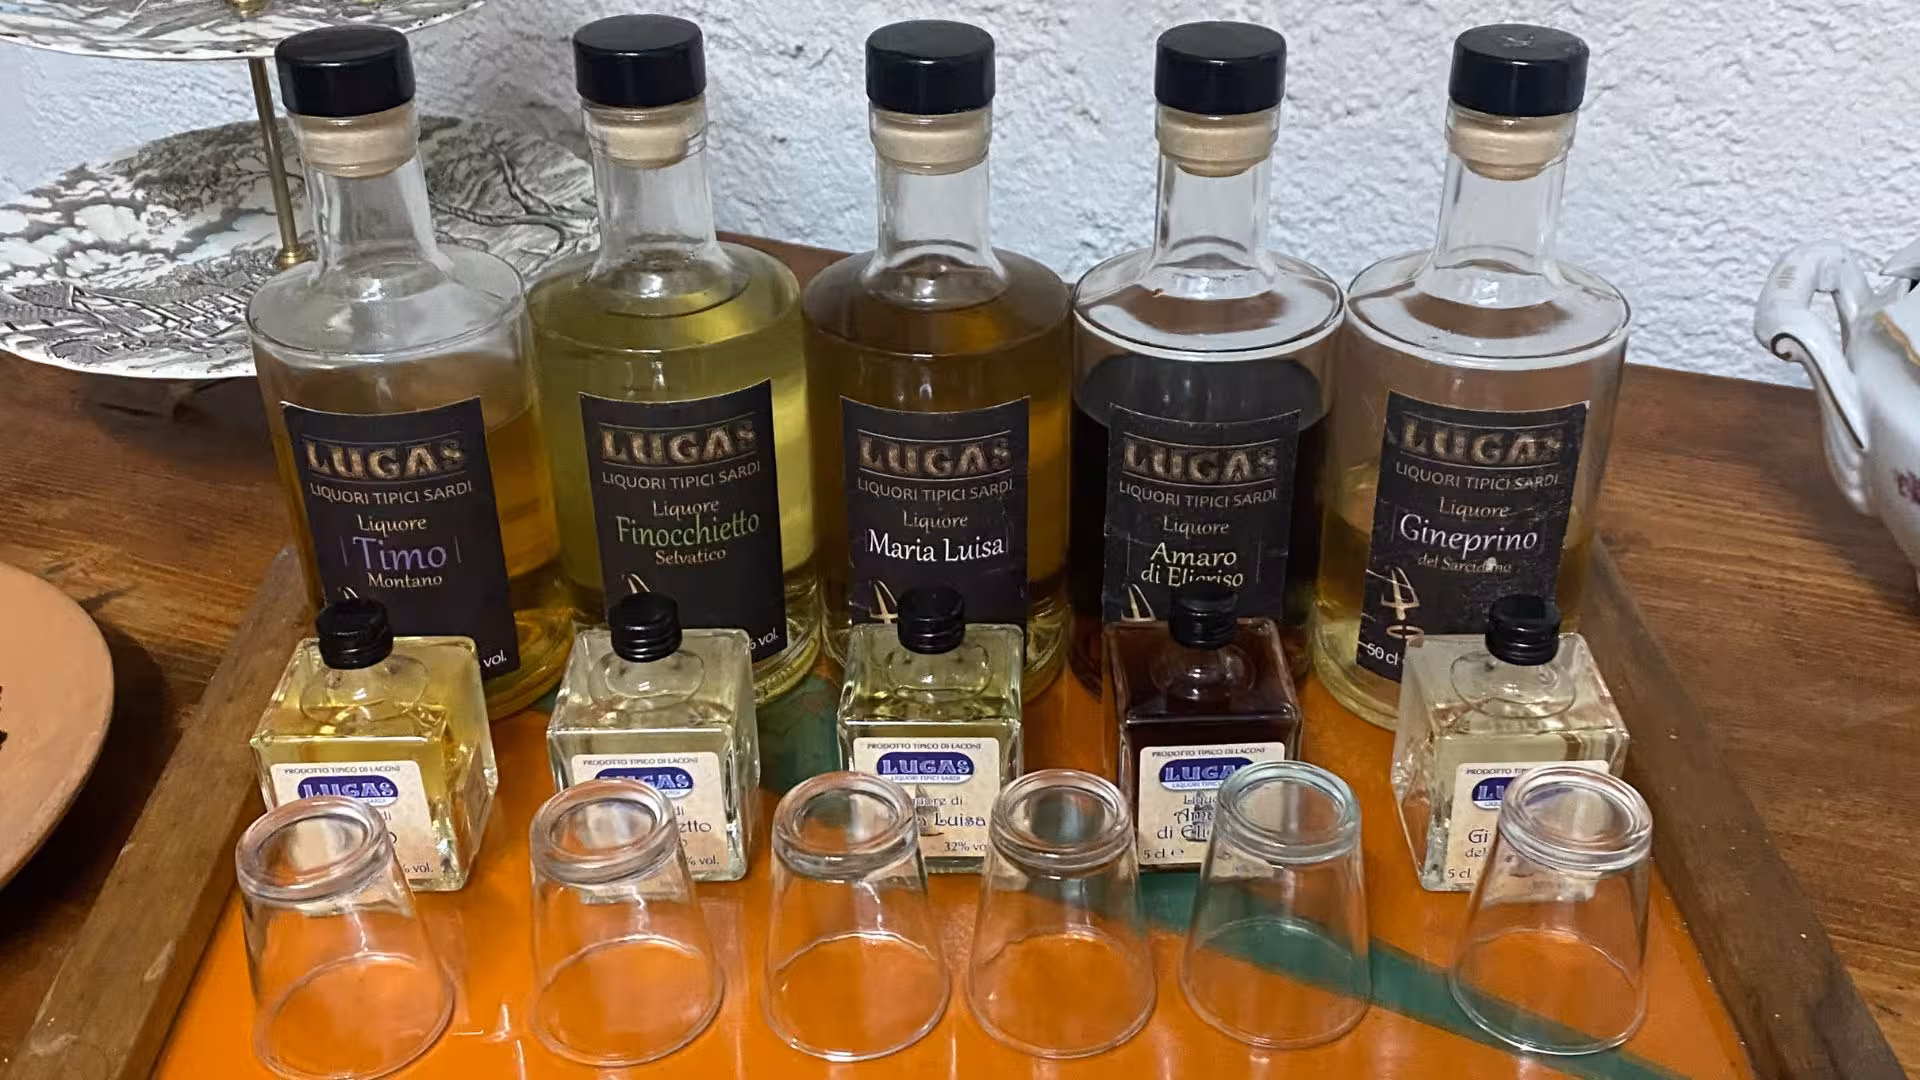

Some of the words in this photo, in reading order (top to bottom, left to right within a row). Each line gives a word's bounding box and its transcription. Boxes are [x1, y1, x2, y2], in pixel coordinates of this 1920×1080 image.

[601, 420, 756, 465] LUGAS
[1402, 418, 1564, 465] LUGAS
[305, 438, 467, 480] LUGAS
[858, 434, 1012, 476] LUGAS
[1123, 438, 1278, 483] LUGAS
[602, 471, 666, 490] LIQUORI
[670, 474, 714, 490] TIPICI
[719, 460, 761, 483] SARDI
[1396, 461, 1460, 487] LIQUORI
[1465, 475, 1510, 490] TIPICI
[1514, 473, 1559, 490] SARDI
[310, 482, 369, 505] LIQUORI
[373, 491, 419, 505] TIPICI
[424, 480, 473, 500] SARDI
[858, 477, 917, 500] LIQUORI
[922, 489, 965, 501] TIPICI
[970, 478, 1013, 500] SARDI
[1119, 480, 1180, 506] LIQUORI
[1185, 495, 1229, 508] TIPICI
[1233, 487, 1277, 507] SARDI
[652, 500, 720, 521] Liquore
[1439, 496, 1510, 521] Liquore
[357, 514, 427, 538] Liquore
[616, 513, 760, 547] Finocchietto
[903, 510, 969, 533] Liquore
[1163, 515, 1230, 539] Liquore
[868, 528, 937, 562] Maria
[943, 535, 1005, 562] Luisa
[1400, 513, 1538, 559] Gineprino
[352, 536, 447, 571] Timo
[655, 549, 726, 565] Selvatico
[1150, 542, 1237, 567] Amaro
[1417, 552, 1438, 568] del
[367, 572, 443, 588] Montano
[1141, 562, 1160, 584] di
[757, 627, 779, 646] vol.
[483, 649, 507, 668] vol.
[1367, 642, 1384, 660] 50
[1386, 651, 1398, 665] cl
[284, 767, 330, 775] PRODOTTO
[331, 766, 357, 774] TIPICO
[370, 765, 401, 773] LACONI
[882, 759, 970, 774] LUGAS
[303, 782, 394, 798] LUGAS
[951, 795, 963, 806] di
[934, 812, 987, 826] Luisa
[1157, 826, 1173, 840] di
[944, 841, 970, 851] 32%
[1143, 850, 1150, 859] 5
[1154, 849, 1165, 859] cl
[412, 862, 433, 873] vol.
[700, 855, 720, 865] vol.
[1447, 869, 1455, 878] 5
[1459, 868, 1471, 878] cl
